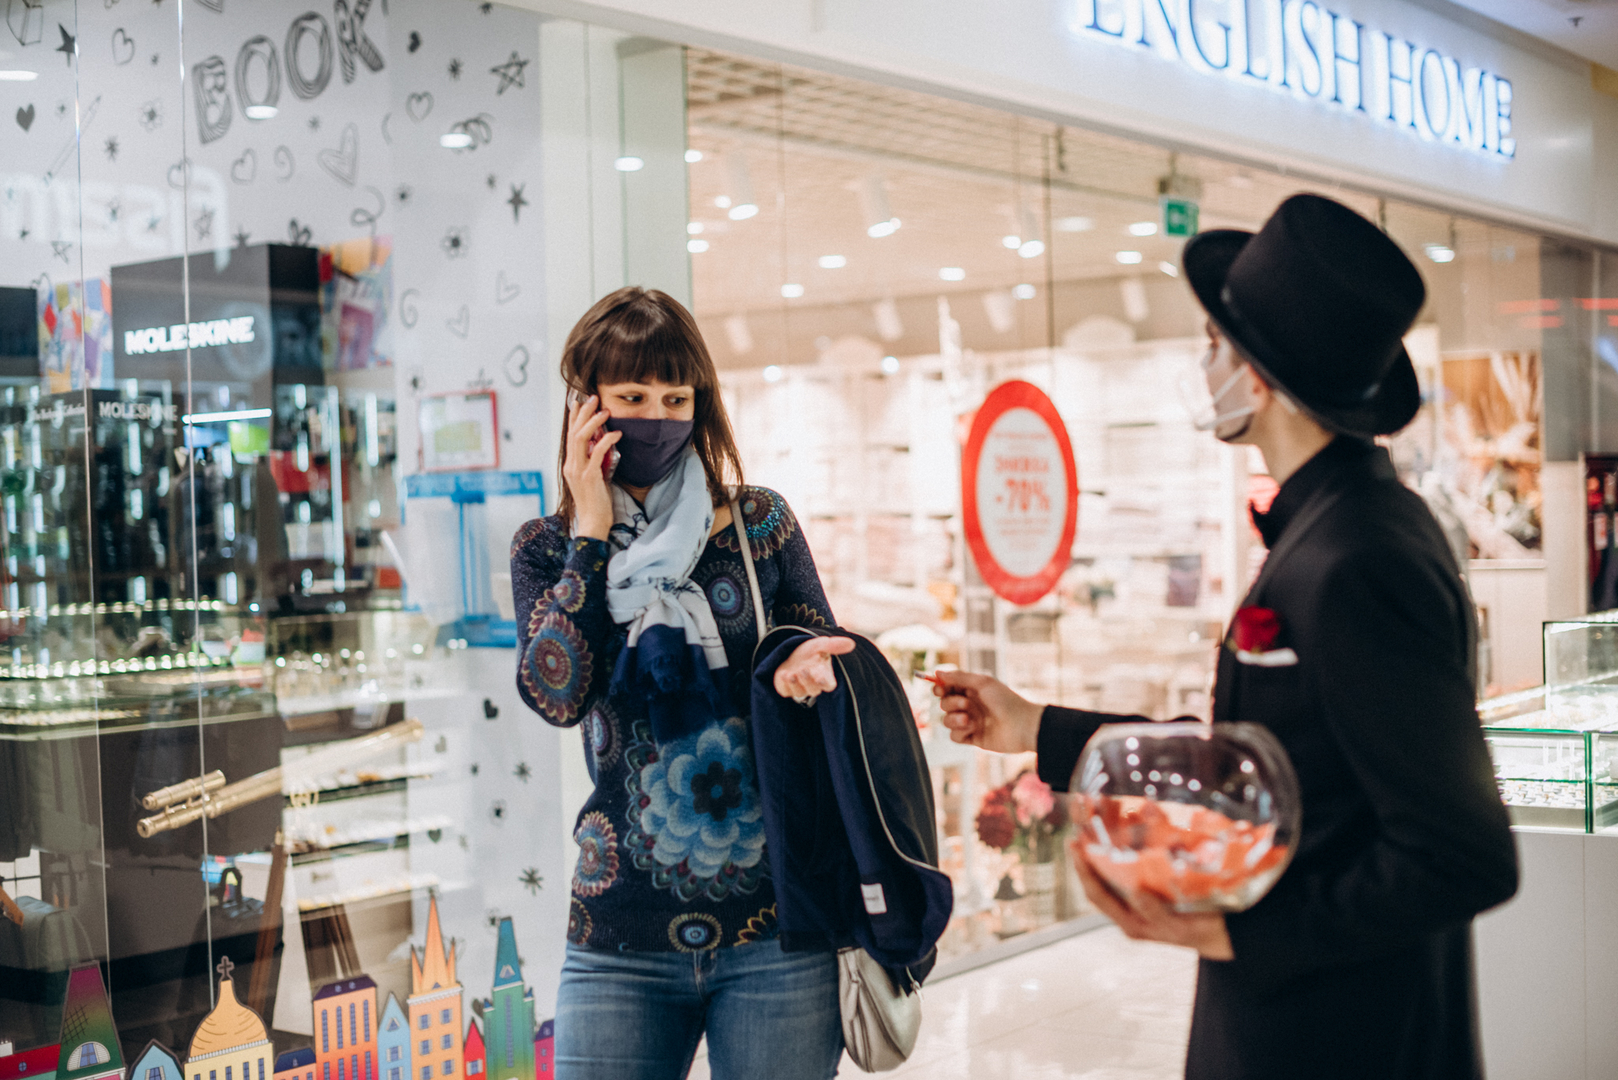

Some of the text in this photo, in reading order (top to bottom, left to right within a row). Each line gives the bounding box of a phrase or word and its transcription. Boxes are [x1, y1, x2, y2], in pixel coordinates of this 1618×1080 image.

[191, 0, 385, 145] BOOK
[1382, 31, 1515, 158] HOME
[124, 315, 255, 355] MOLESKINE
[99, 401, 179, 423] MOLESNE
